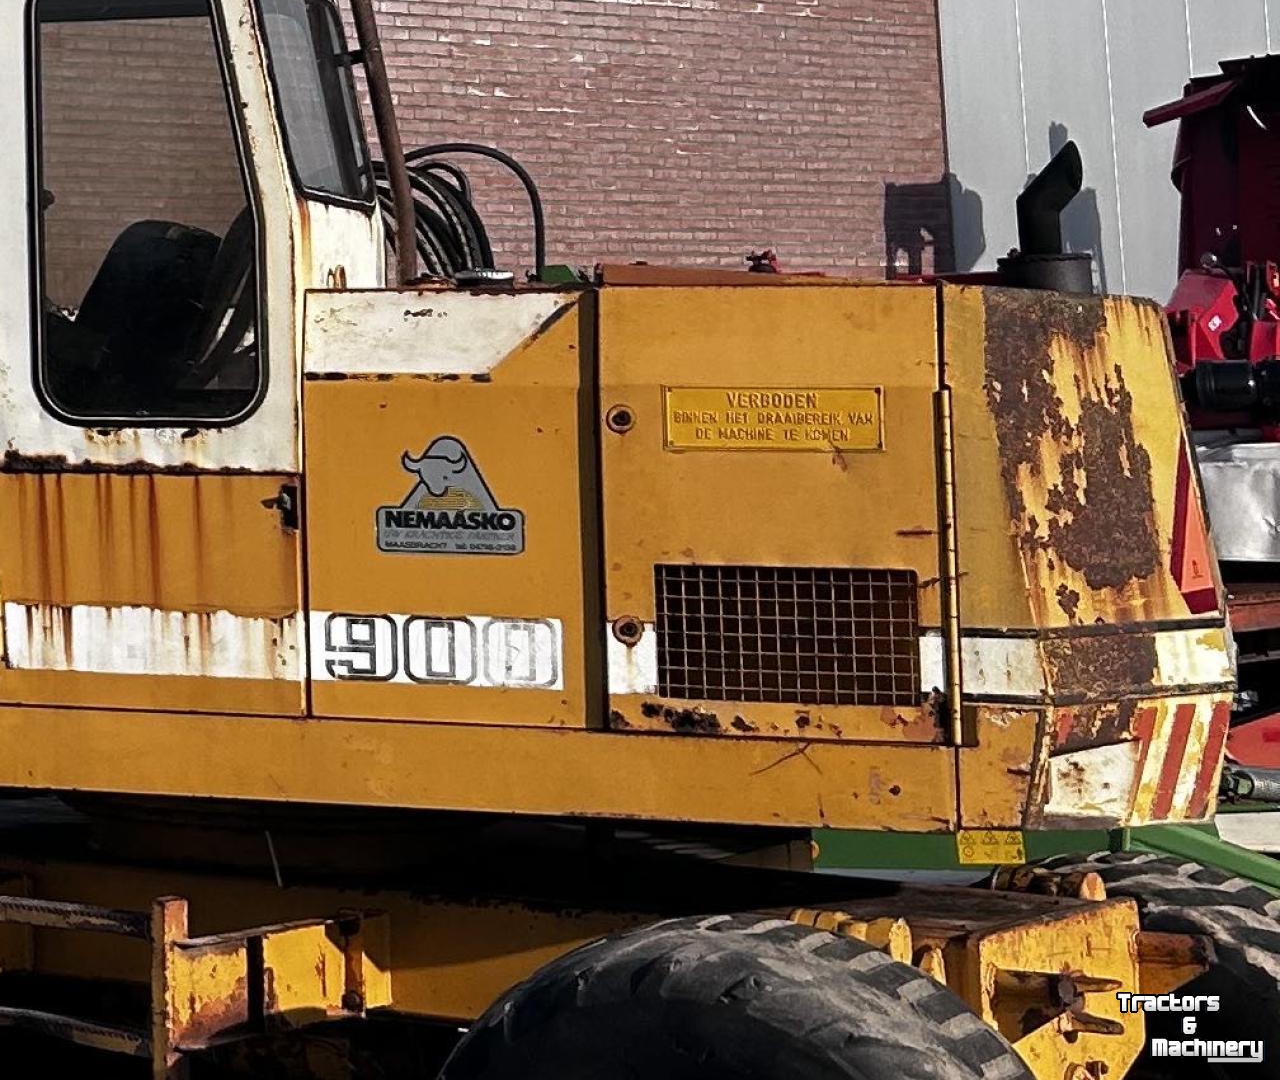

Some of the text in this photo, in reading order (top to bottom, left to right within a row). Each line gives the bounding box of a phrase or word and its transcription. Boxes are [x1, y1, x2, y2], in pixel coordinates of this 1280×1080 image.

[726, 392, 817, 408] VERBODEN
[673, 411, 873, 425] BINNEN HET DRAAIBEREIK VAN
[695, 427, 849, 441] DE MACHINE TE KOMEN
[385, 510, 516, 531] NEMAASKO
[324, 612, 557, 688] 900
